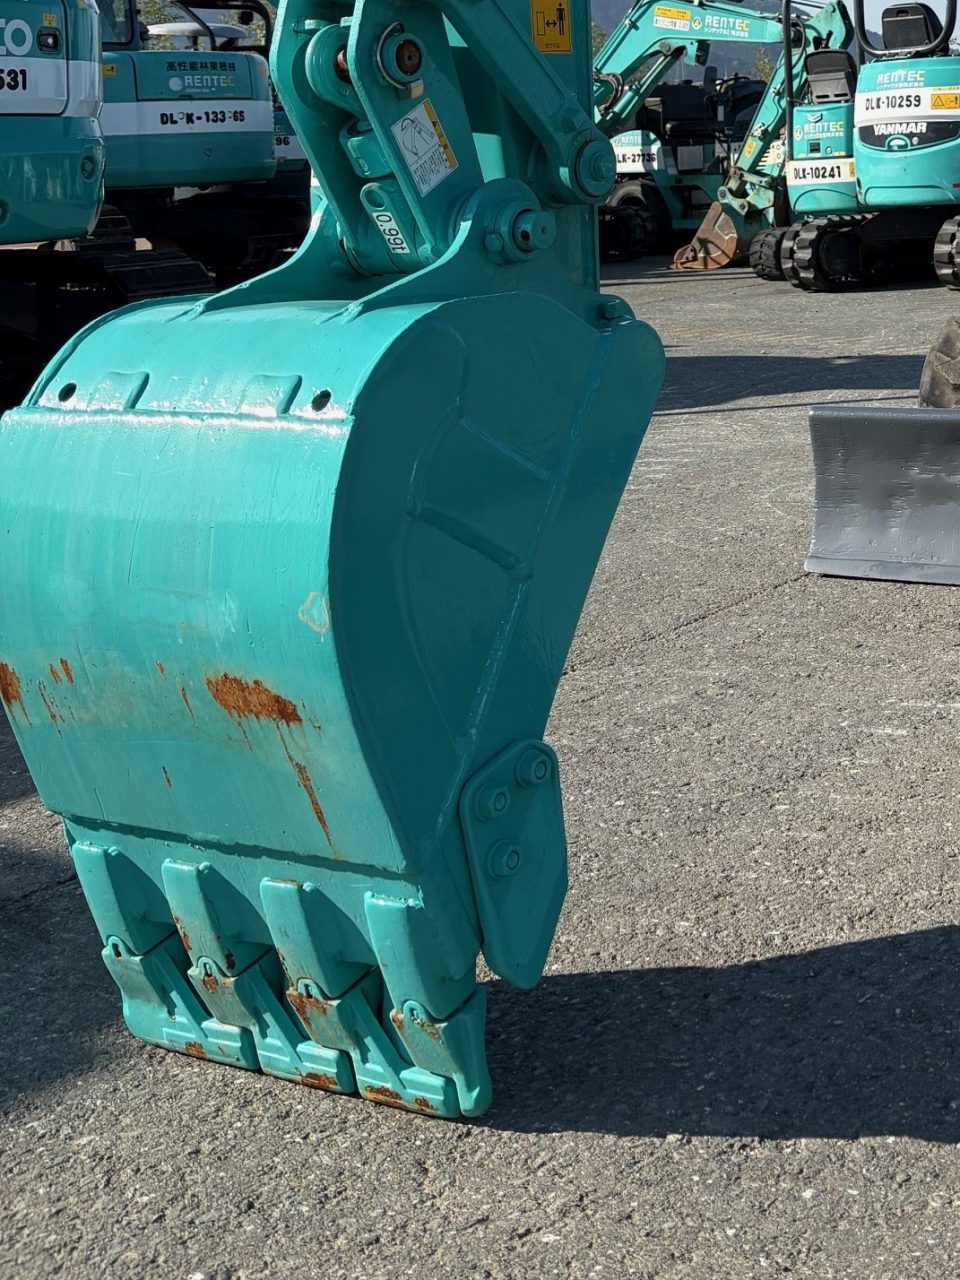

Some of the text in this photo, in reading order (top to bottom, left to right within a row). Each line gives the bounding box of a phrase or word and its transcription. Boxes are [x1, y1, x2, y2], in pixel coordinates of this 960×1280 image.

[704, 15, 750, 31] RENTEC
[0, 19, 33, 56] O
[876, 69, 926, 84] RENTEC
[865, 95, 922, 111] DLK-10259
[803, 121, 845, 133] RENTEC
[872, 122, 928, 136] YANMAR
[793, 165, 841, 180] DLK-10241
[375, 213, 407, 253] 0.99t
